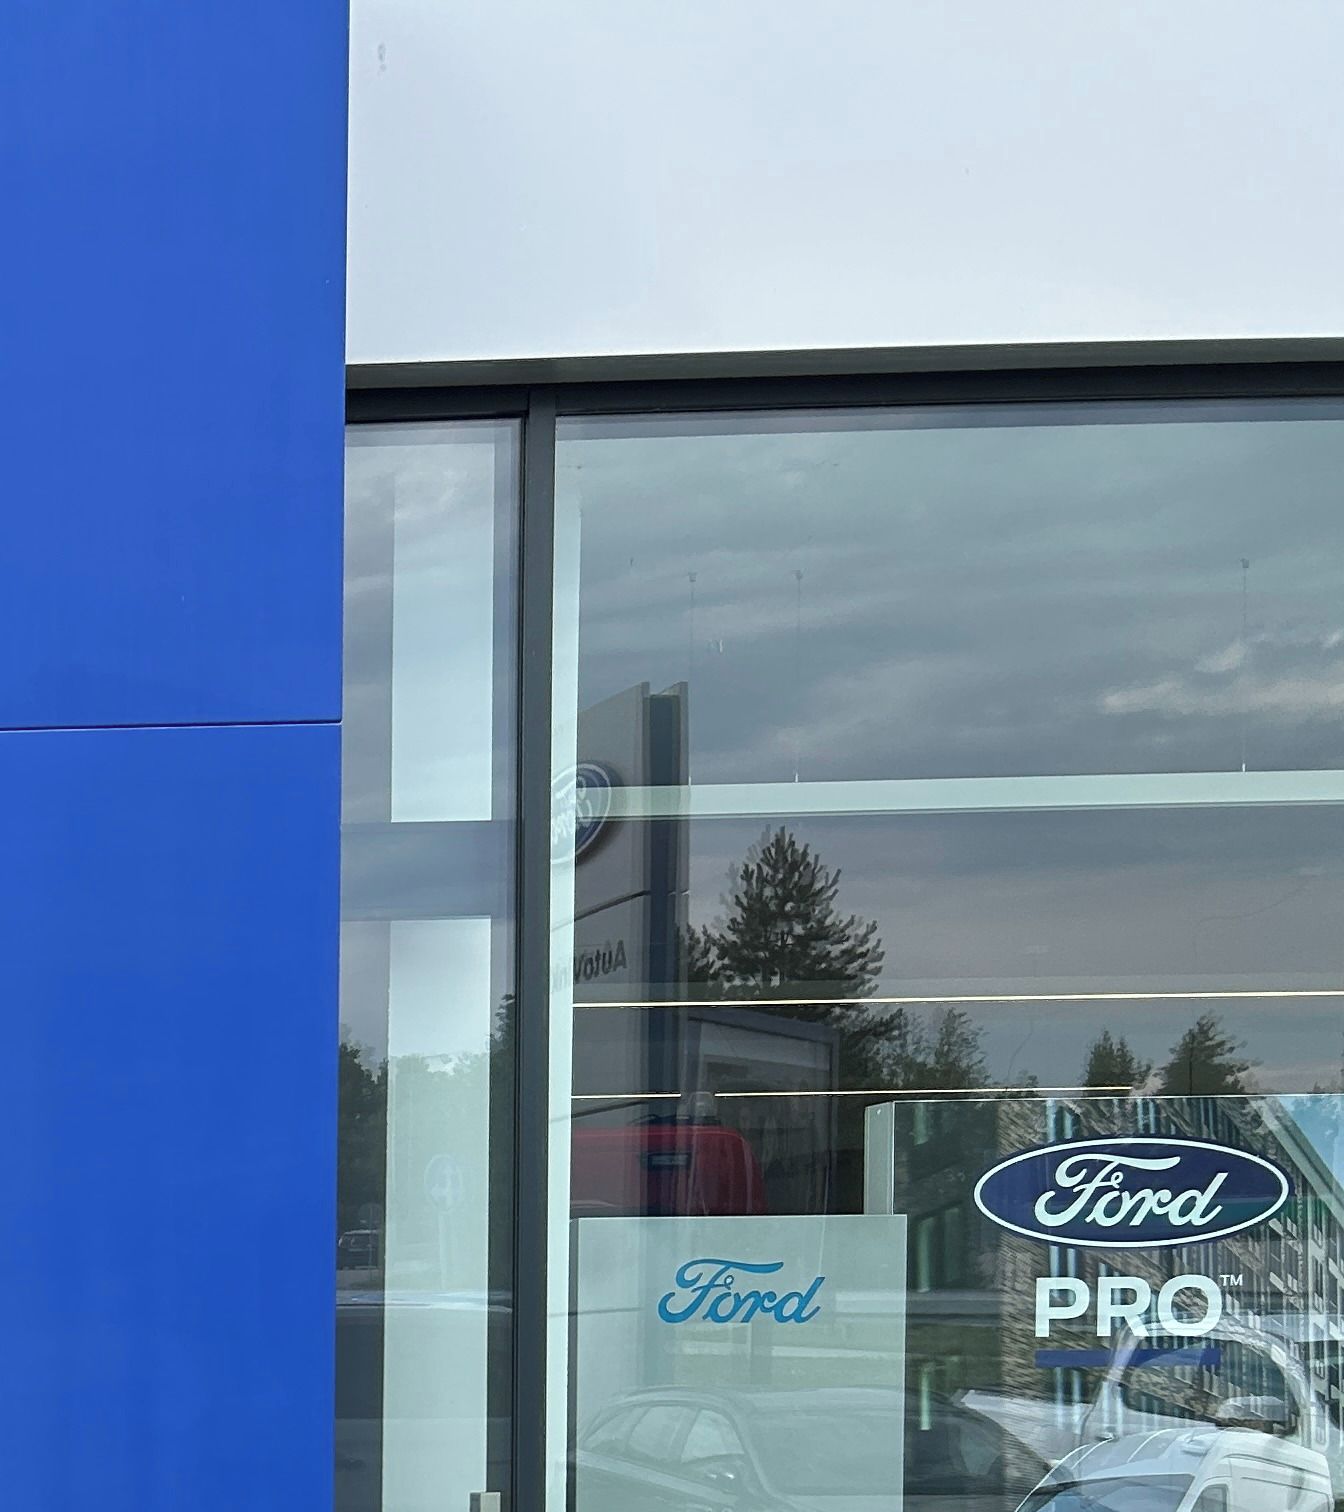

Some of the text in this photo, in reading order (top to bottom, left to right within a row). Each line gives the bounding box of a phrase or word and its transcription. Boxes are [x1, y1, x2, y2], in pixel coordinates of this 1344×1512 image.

[1034, 1152, 1229, 1228] Ford
[657, 1257, 827, 1325] Ford
[1034, 1273, 1222, 1339] PRO
